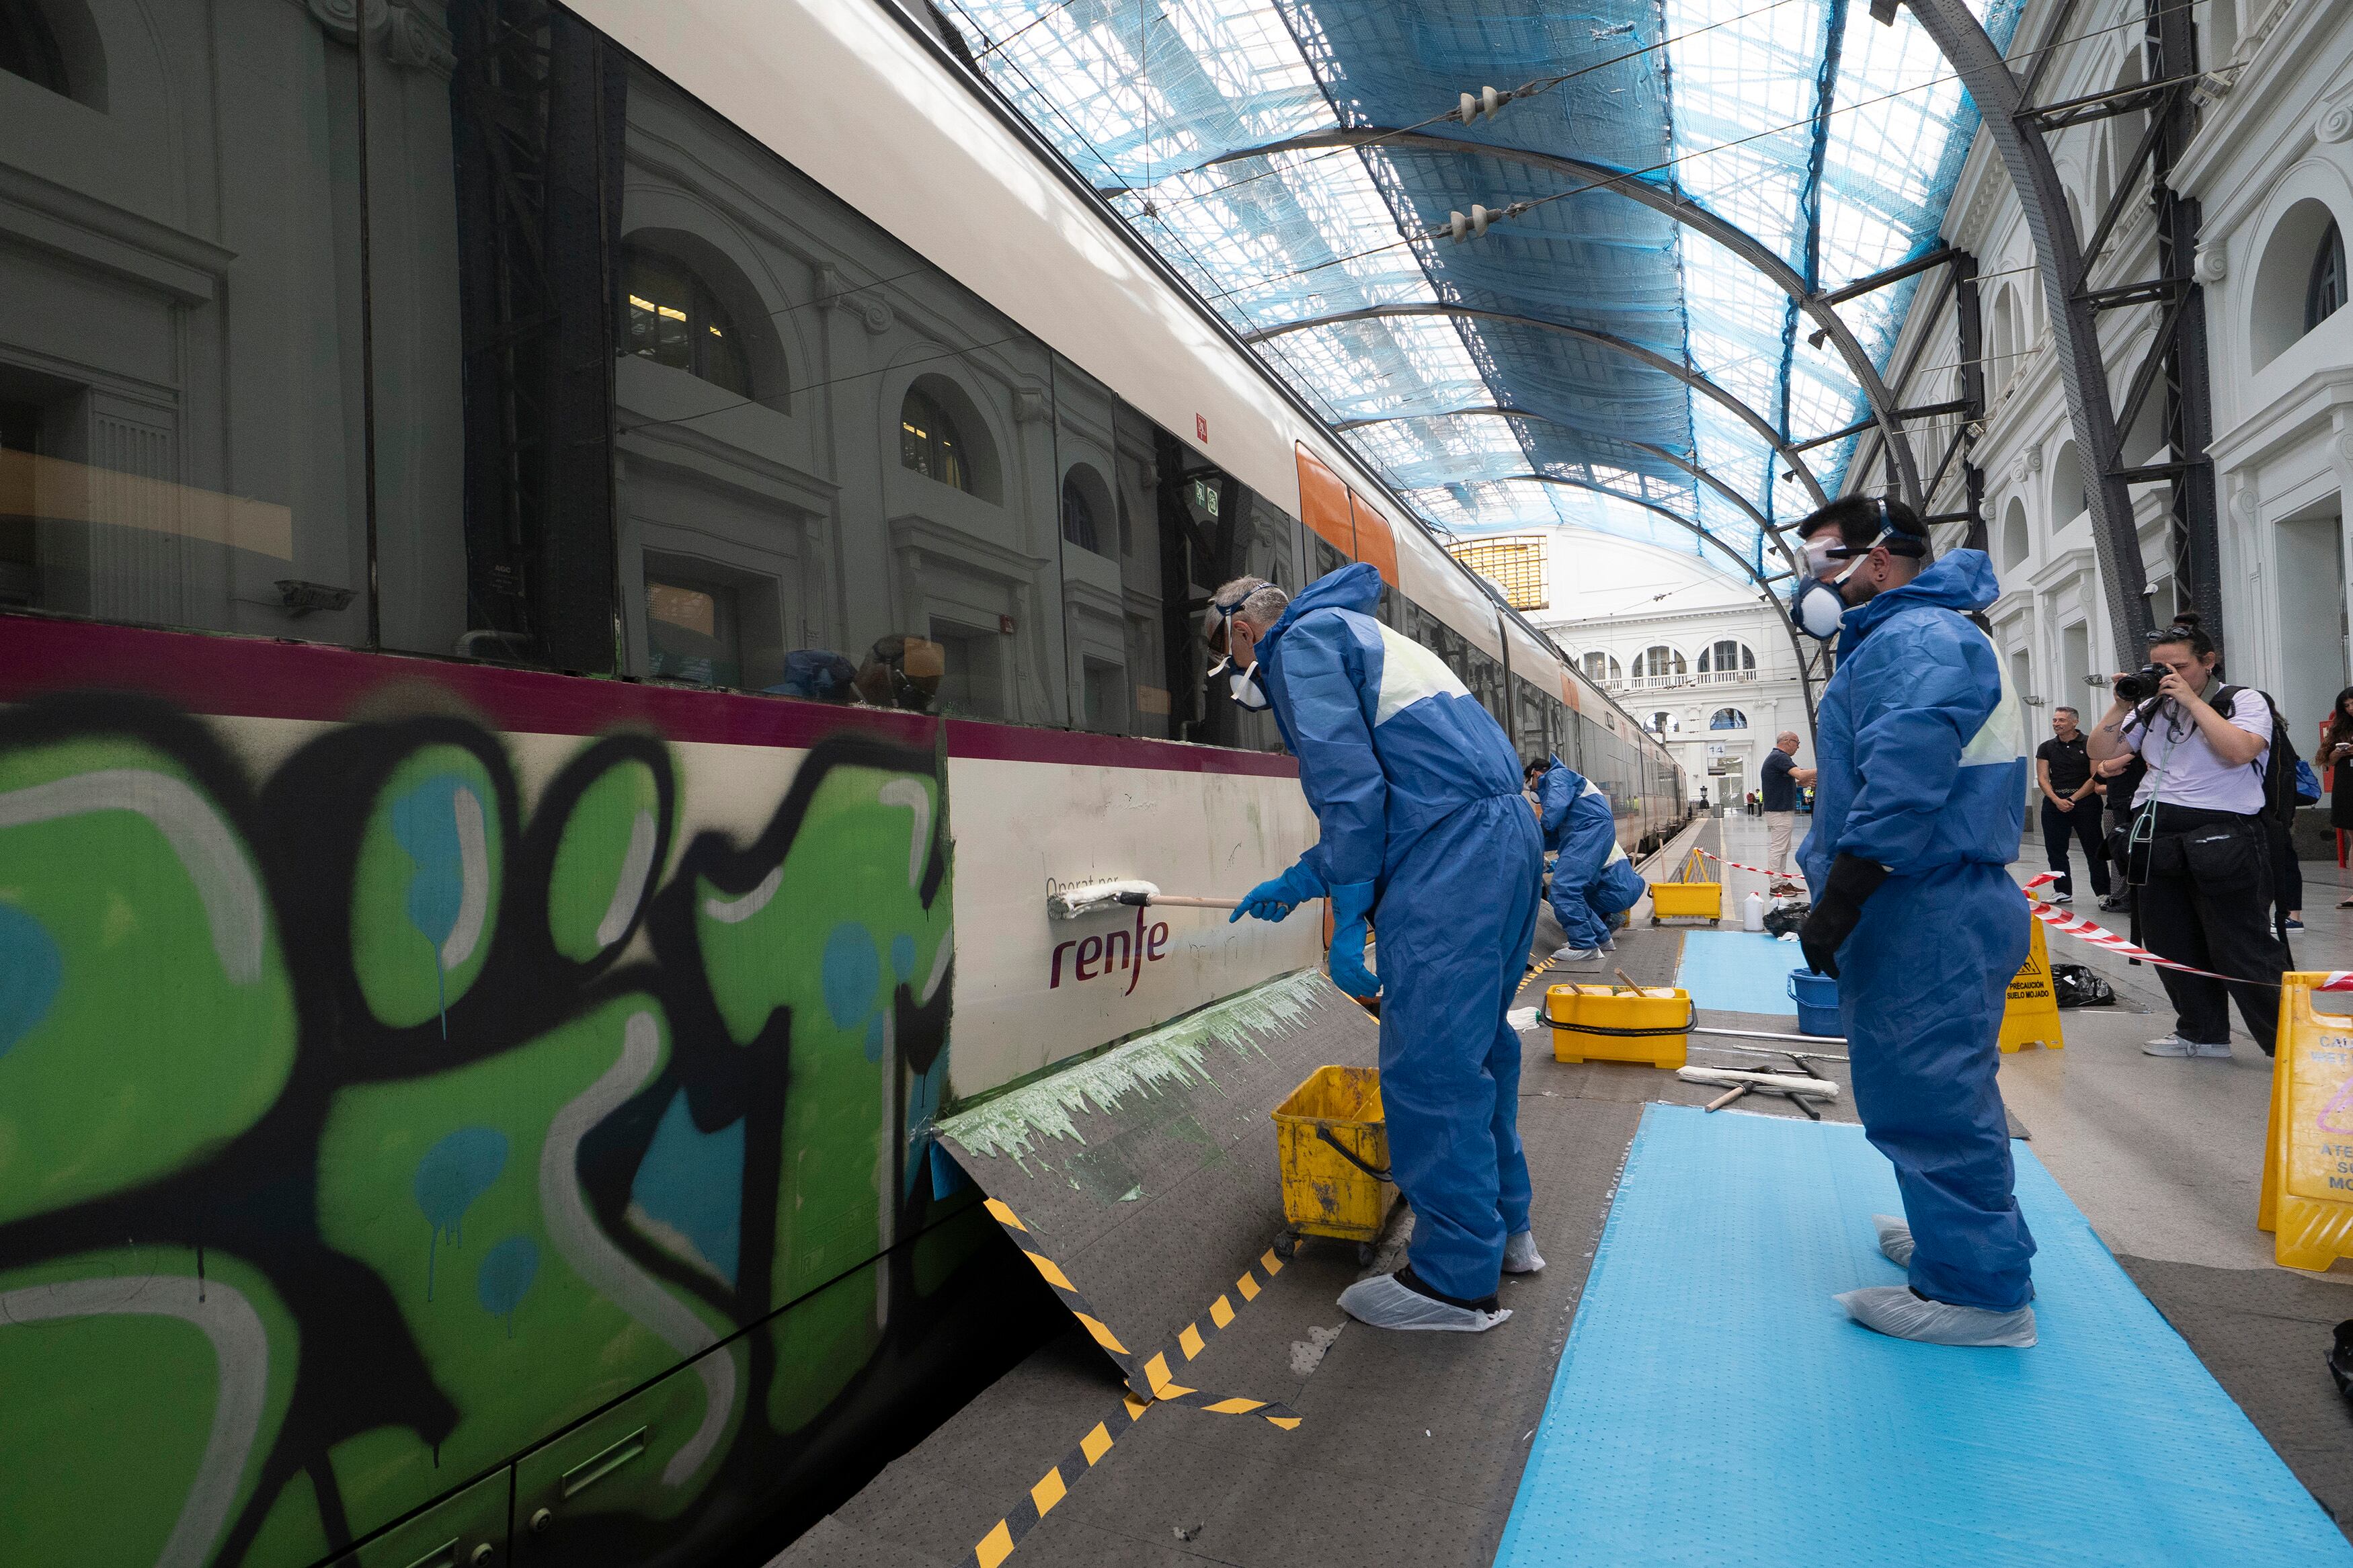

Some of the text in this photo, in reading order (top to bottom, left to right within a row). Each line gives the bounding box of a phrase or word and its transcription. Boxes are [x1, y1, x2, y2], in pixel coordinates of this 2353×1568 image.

[1709, 745, 1724, 754] 14
[1049, 906, 1168, 997] renfe
[2009, 980, 2044, 990] PRECAUCIÓN
[2007, 990, 2049, 999] SUELO MOJADO
[2337, 1161, 2353, 1173] S
